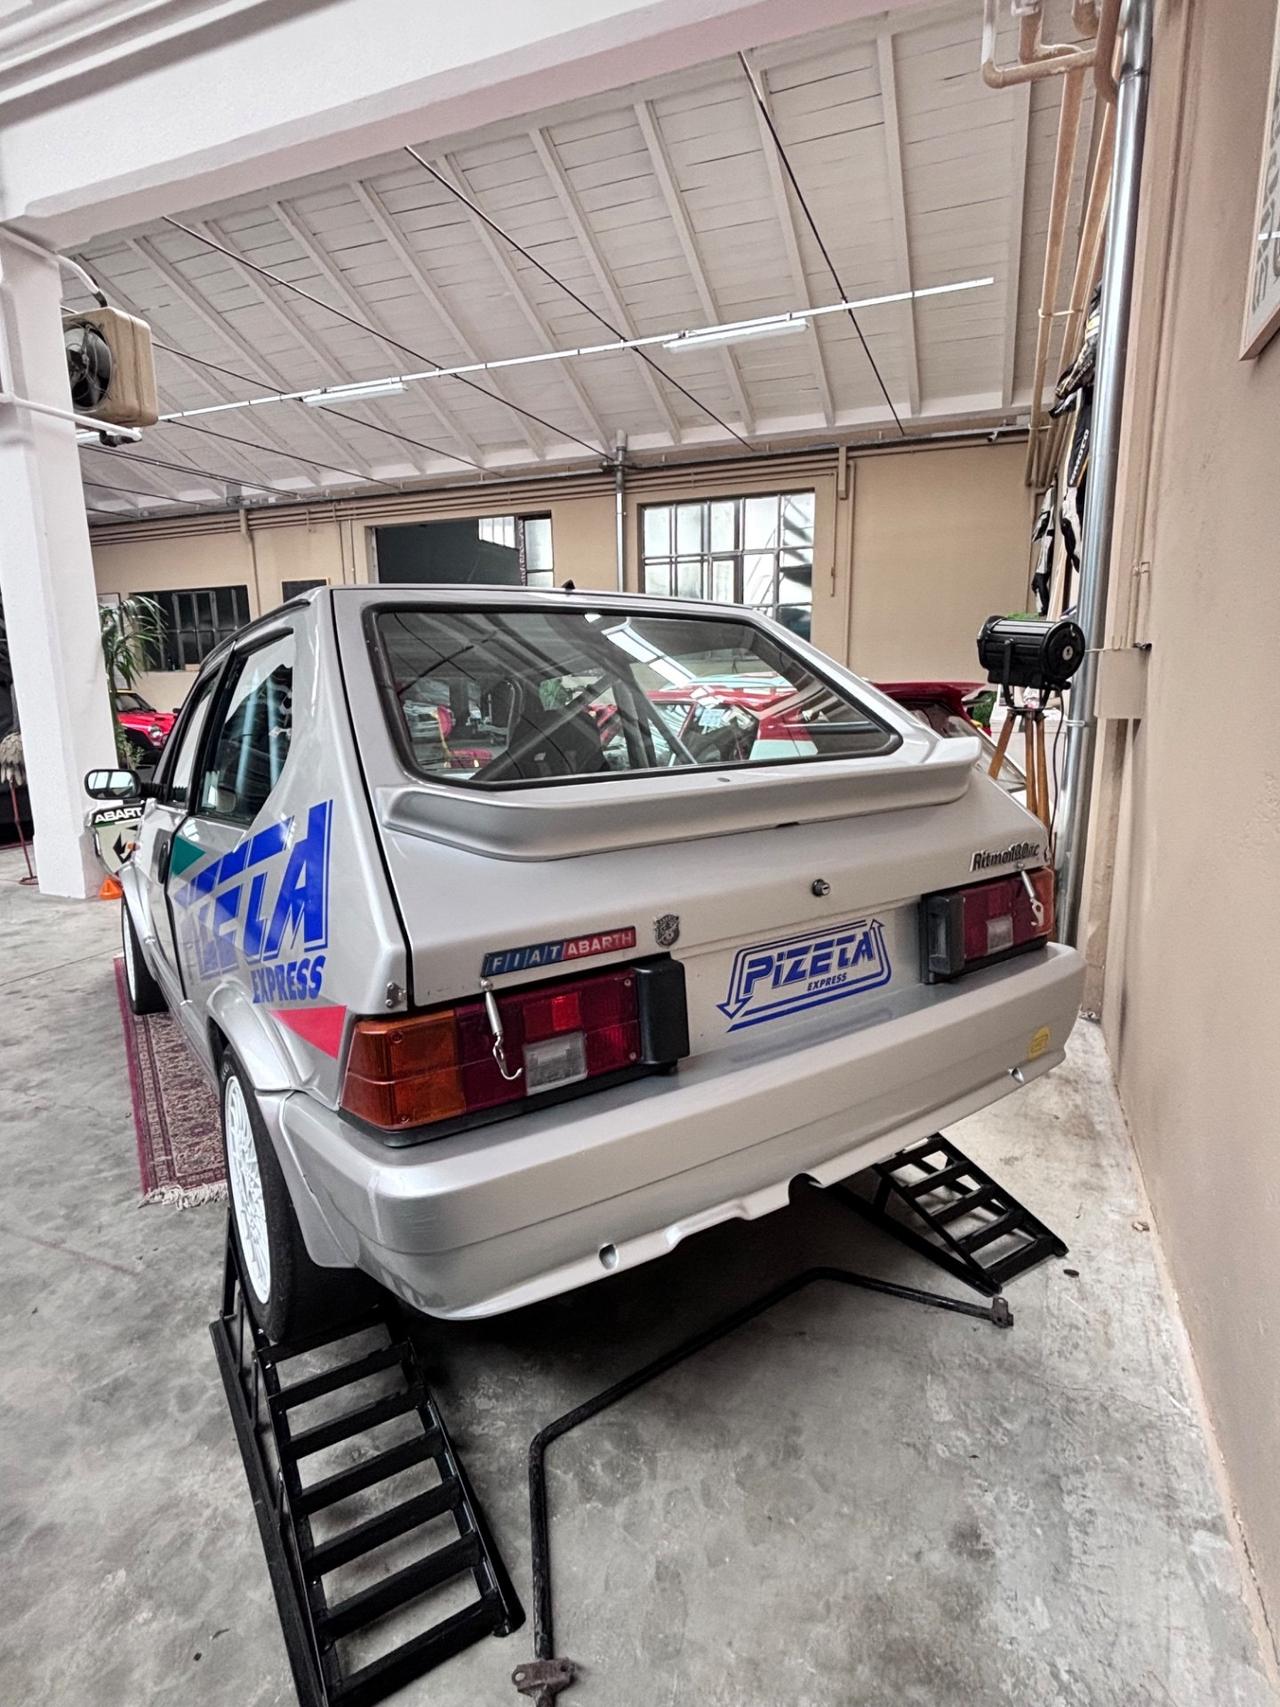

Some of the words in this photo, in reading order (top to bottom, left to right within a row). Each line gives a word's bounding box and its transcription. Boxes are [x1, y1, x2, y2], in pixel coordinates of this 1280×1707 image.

[492, 945, 561, 972] FIAT
[566, 931, 633, 956] ABARTH
[252, 955, 326, 1003] EXPRESS
[807, 972, 847, 991] EXPRESS
